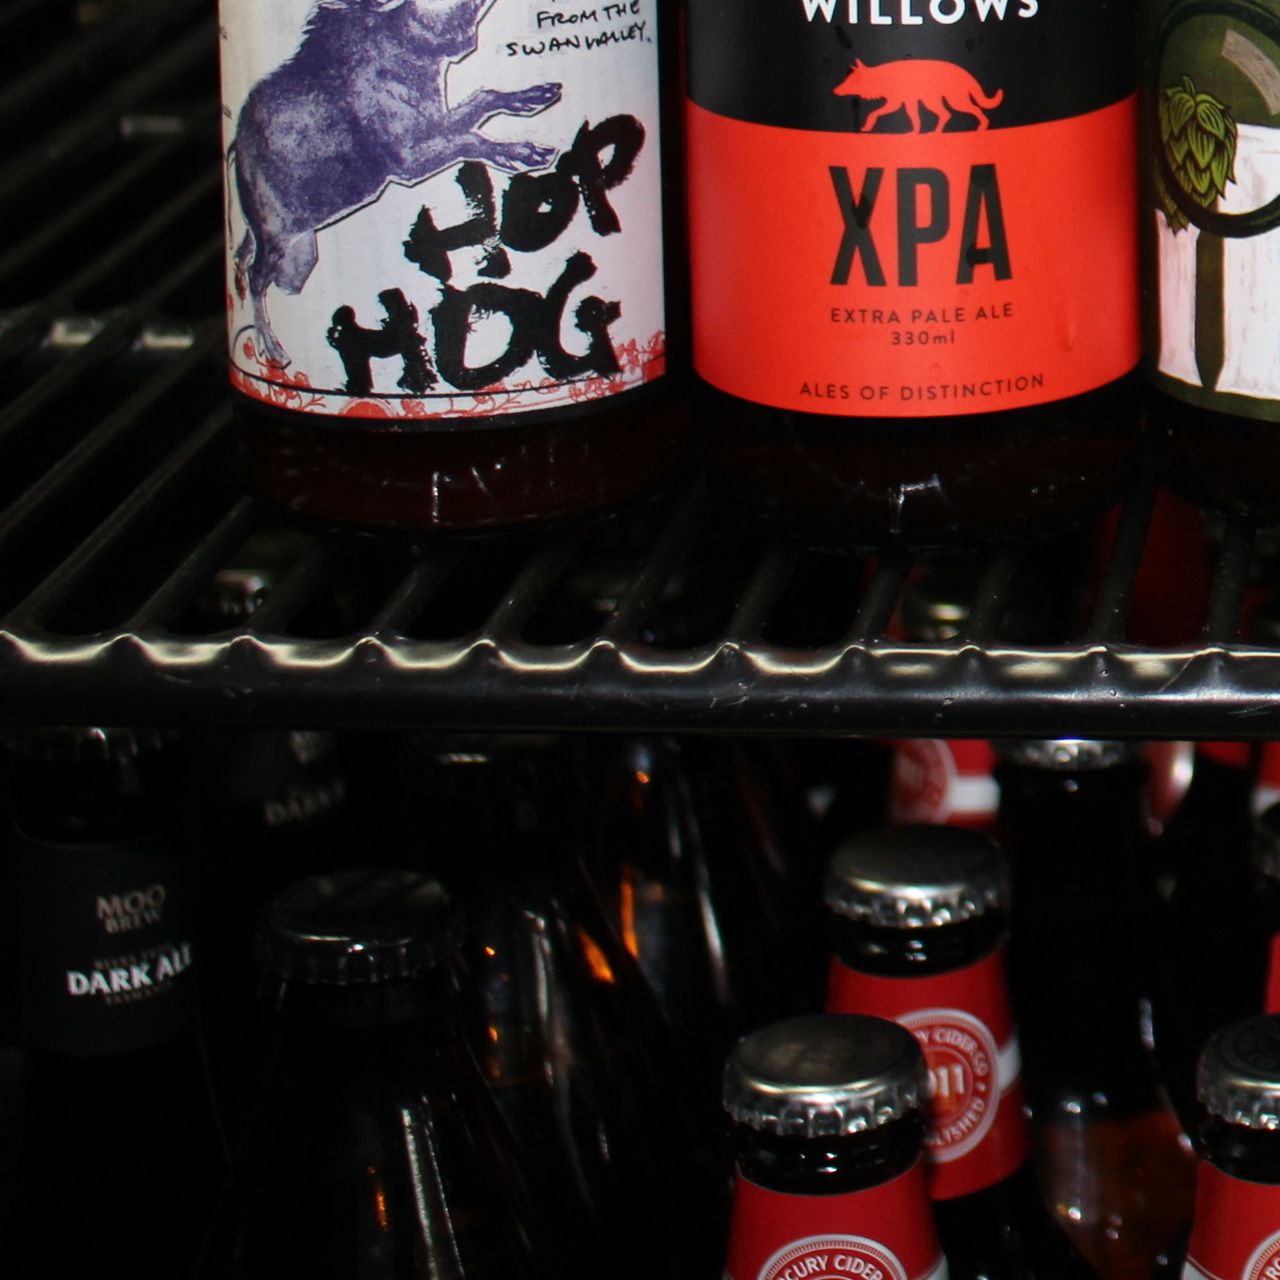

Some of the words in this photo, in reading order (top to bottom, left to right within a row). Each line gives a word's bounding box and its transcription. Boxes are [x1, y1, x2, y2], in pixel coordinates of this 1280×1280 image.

[536, 10, 597, 29] FROM
[505, 33, 581, 58] SWAN
[404, 113, 645, 280] HOP
[828, 163, 1013, 287] XPA
[325, 251, 623, 397] HOG
[831, 307, 900, 324] EXTRA
[911, 307, 965, 324] PALE
[975, 303, 1014, 321] ALE
[891, 330, 955, 346] 330ml
[800, 381, 851, 401] ALES
[860, 385, 889, 401] OF
[901, 373, 1045, 402] DISTINCTION
[96, 884, 166, 919] MOO
[66, 961, 152, 995] DARK
[784, 1255, 829, 1280] CURY
